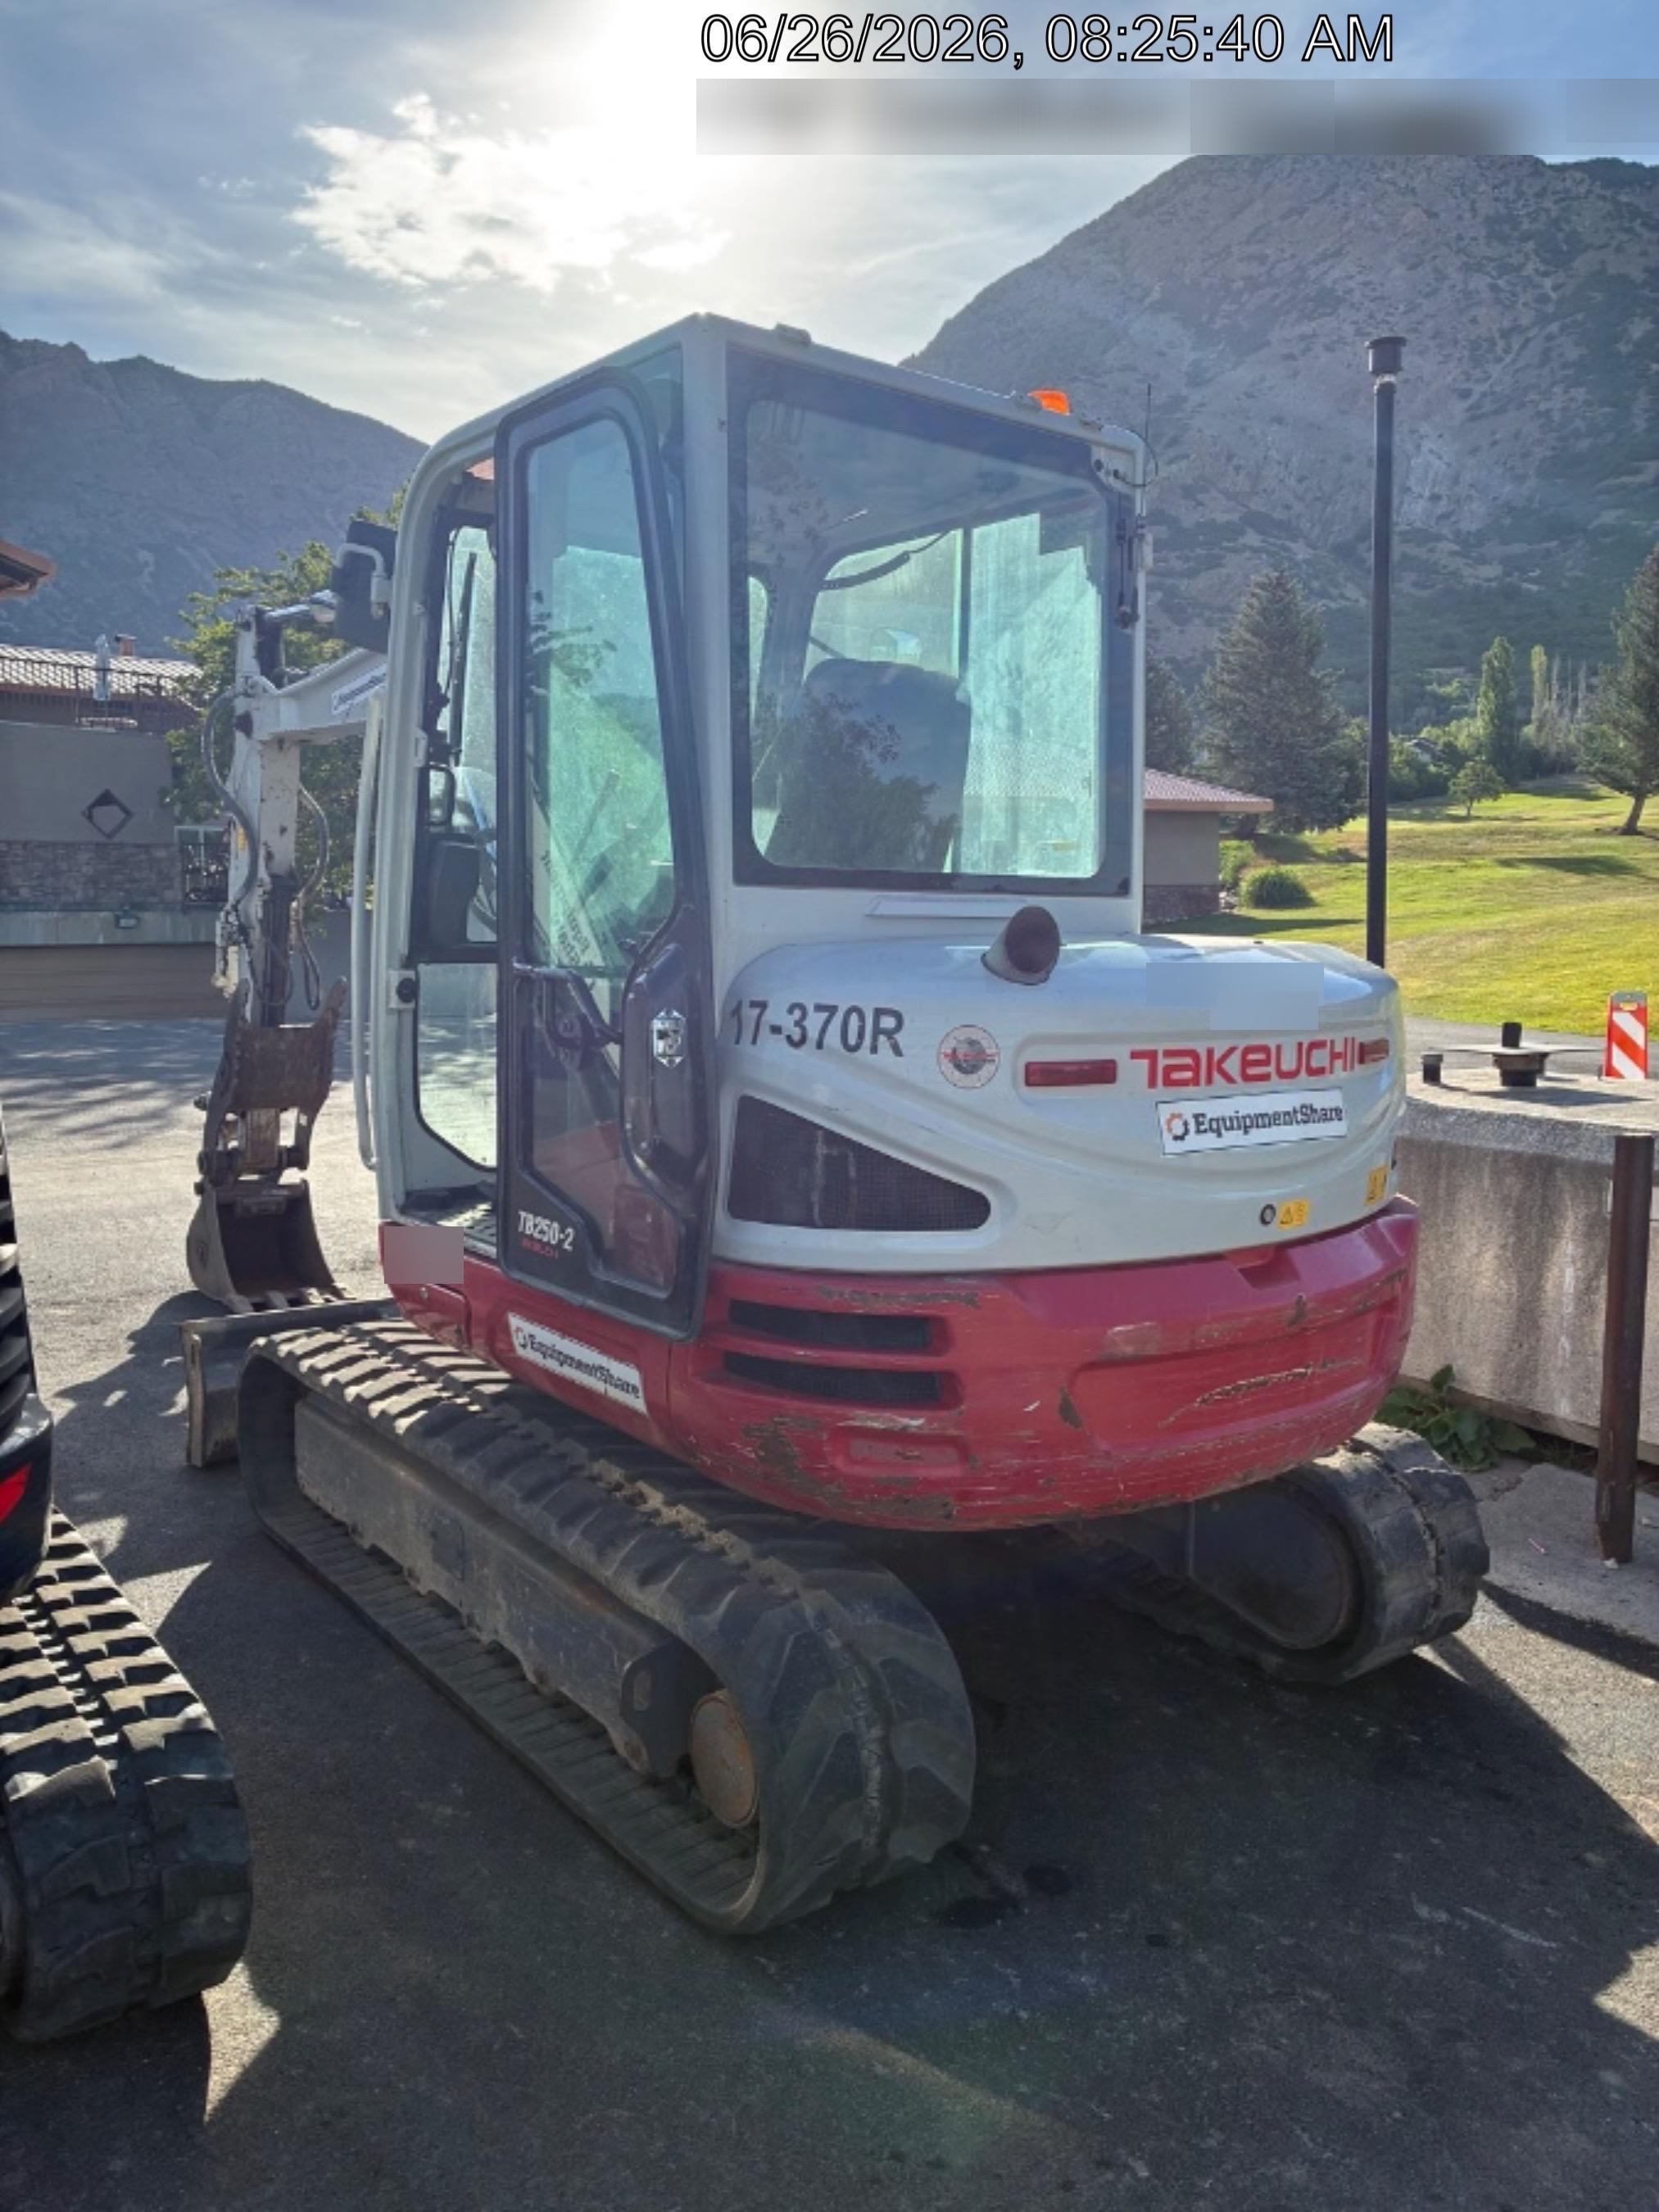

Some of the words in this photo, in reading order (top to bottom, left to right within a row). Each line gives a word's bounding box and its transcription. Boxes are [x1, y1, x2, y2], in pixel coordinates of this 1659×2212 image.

[731, 999, 904, 1057] 17-370R
[1130, 1036, 1355, 1089] TAKEUCHI
[1191, 1103, 1344, 1138] EquipmentShare
[517, 1210, 575, 1252] TB250-2
[528, 1333, 640, 1399] EquipmentShare
